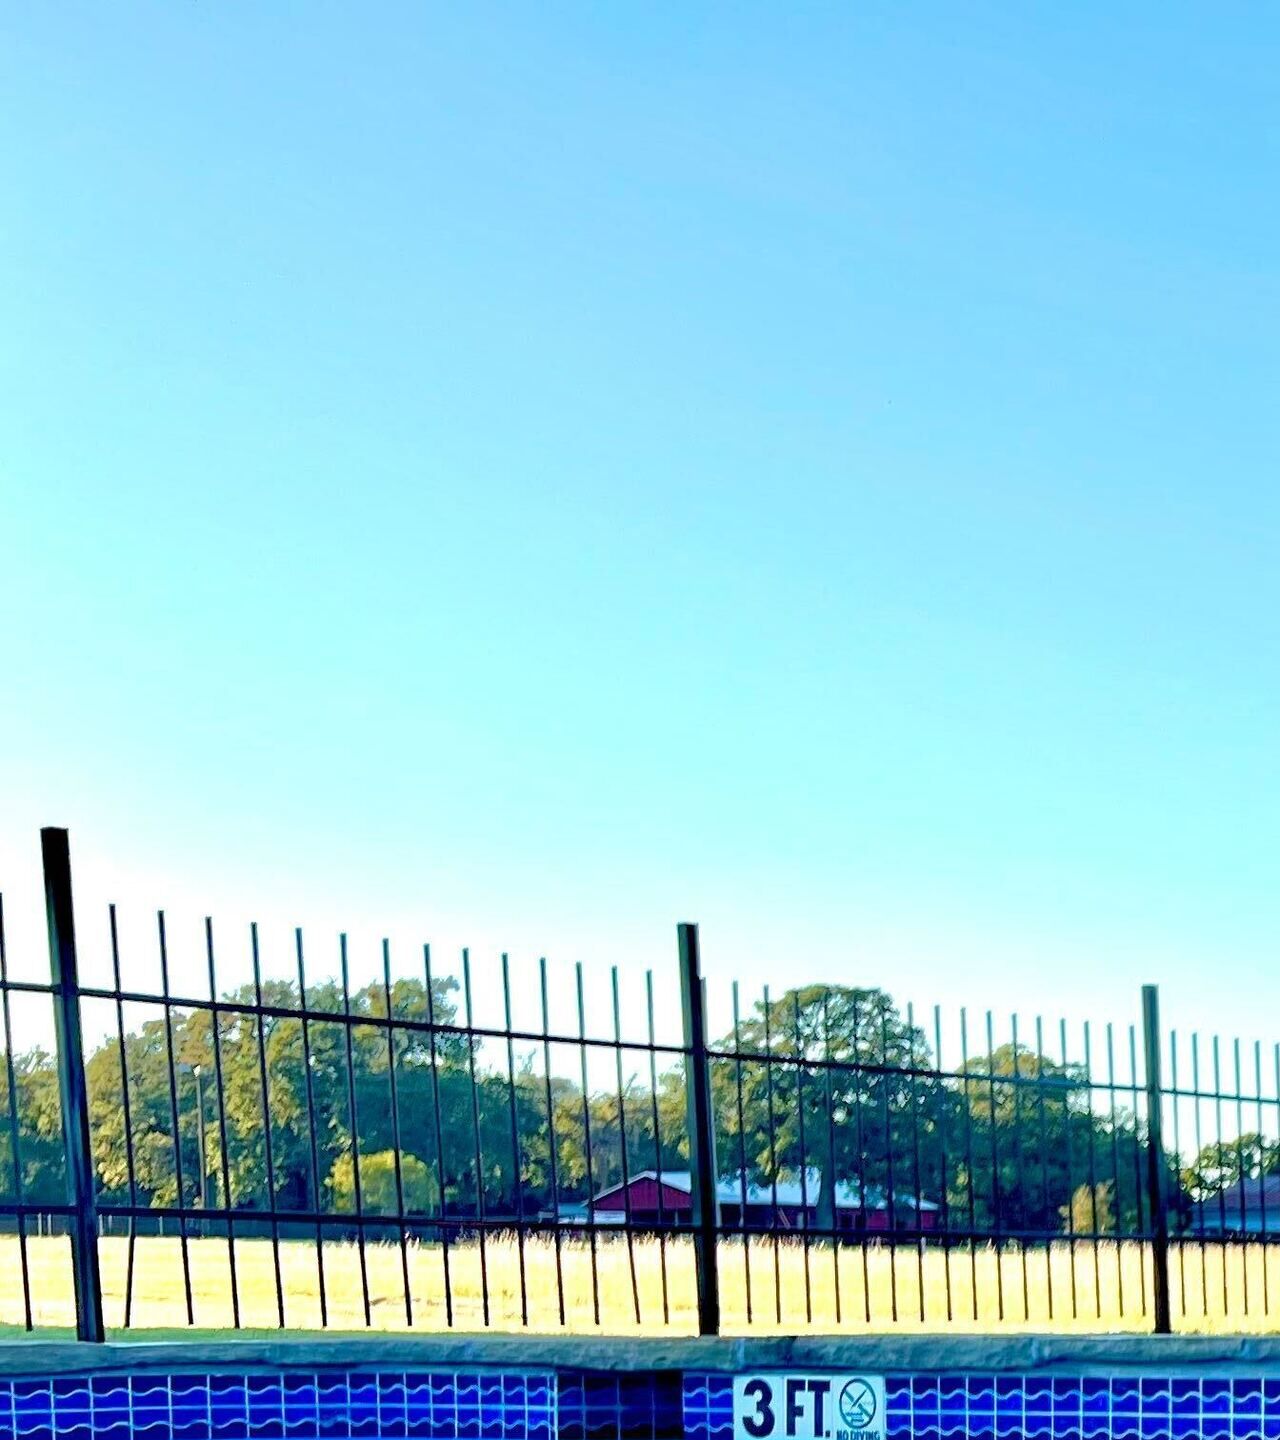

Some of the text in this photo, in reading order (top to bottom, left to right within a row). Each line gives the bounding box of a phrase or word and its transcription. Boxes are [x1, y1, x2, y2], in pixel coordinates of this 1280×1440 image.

[742, 1378, 831, 1438] 3 FT.
[836, 1430, 849, 1440] NO
